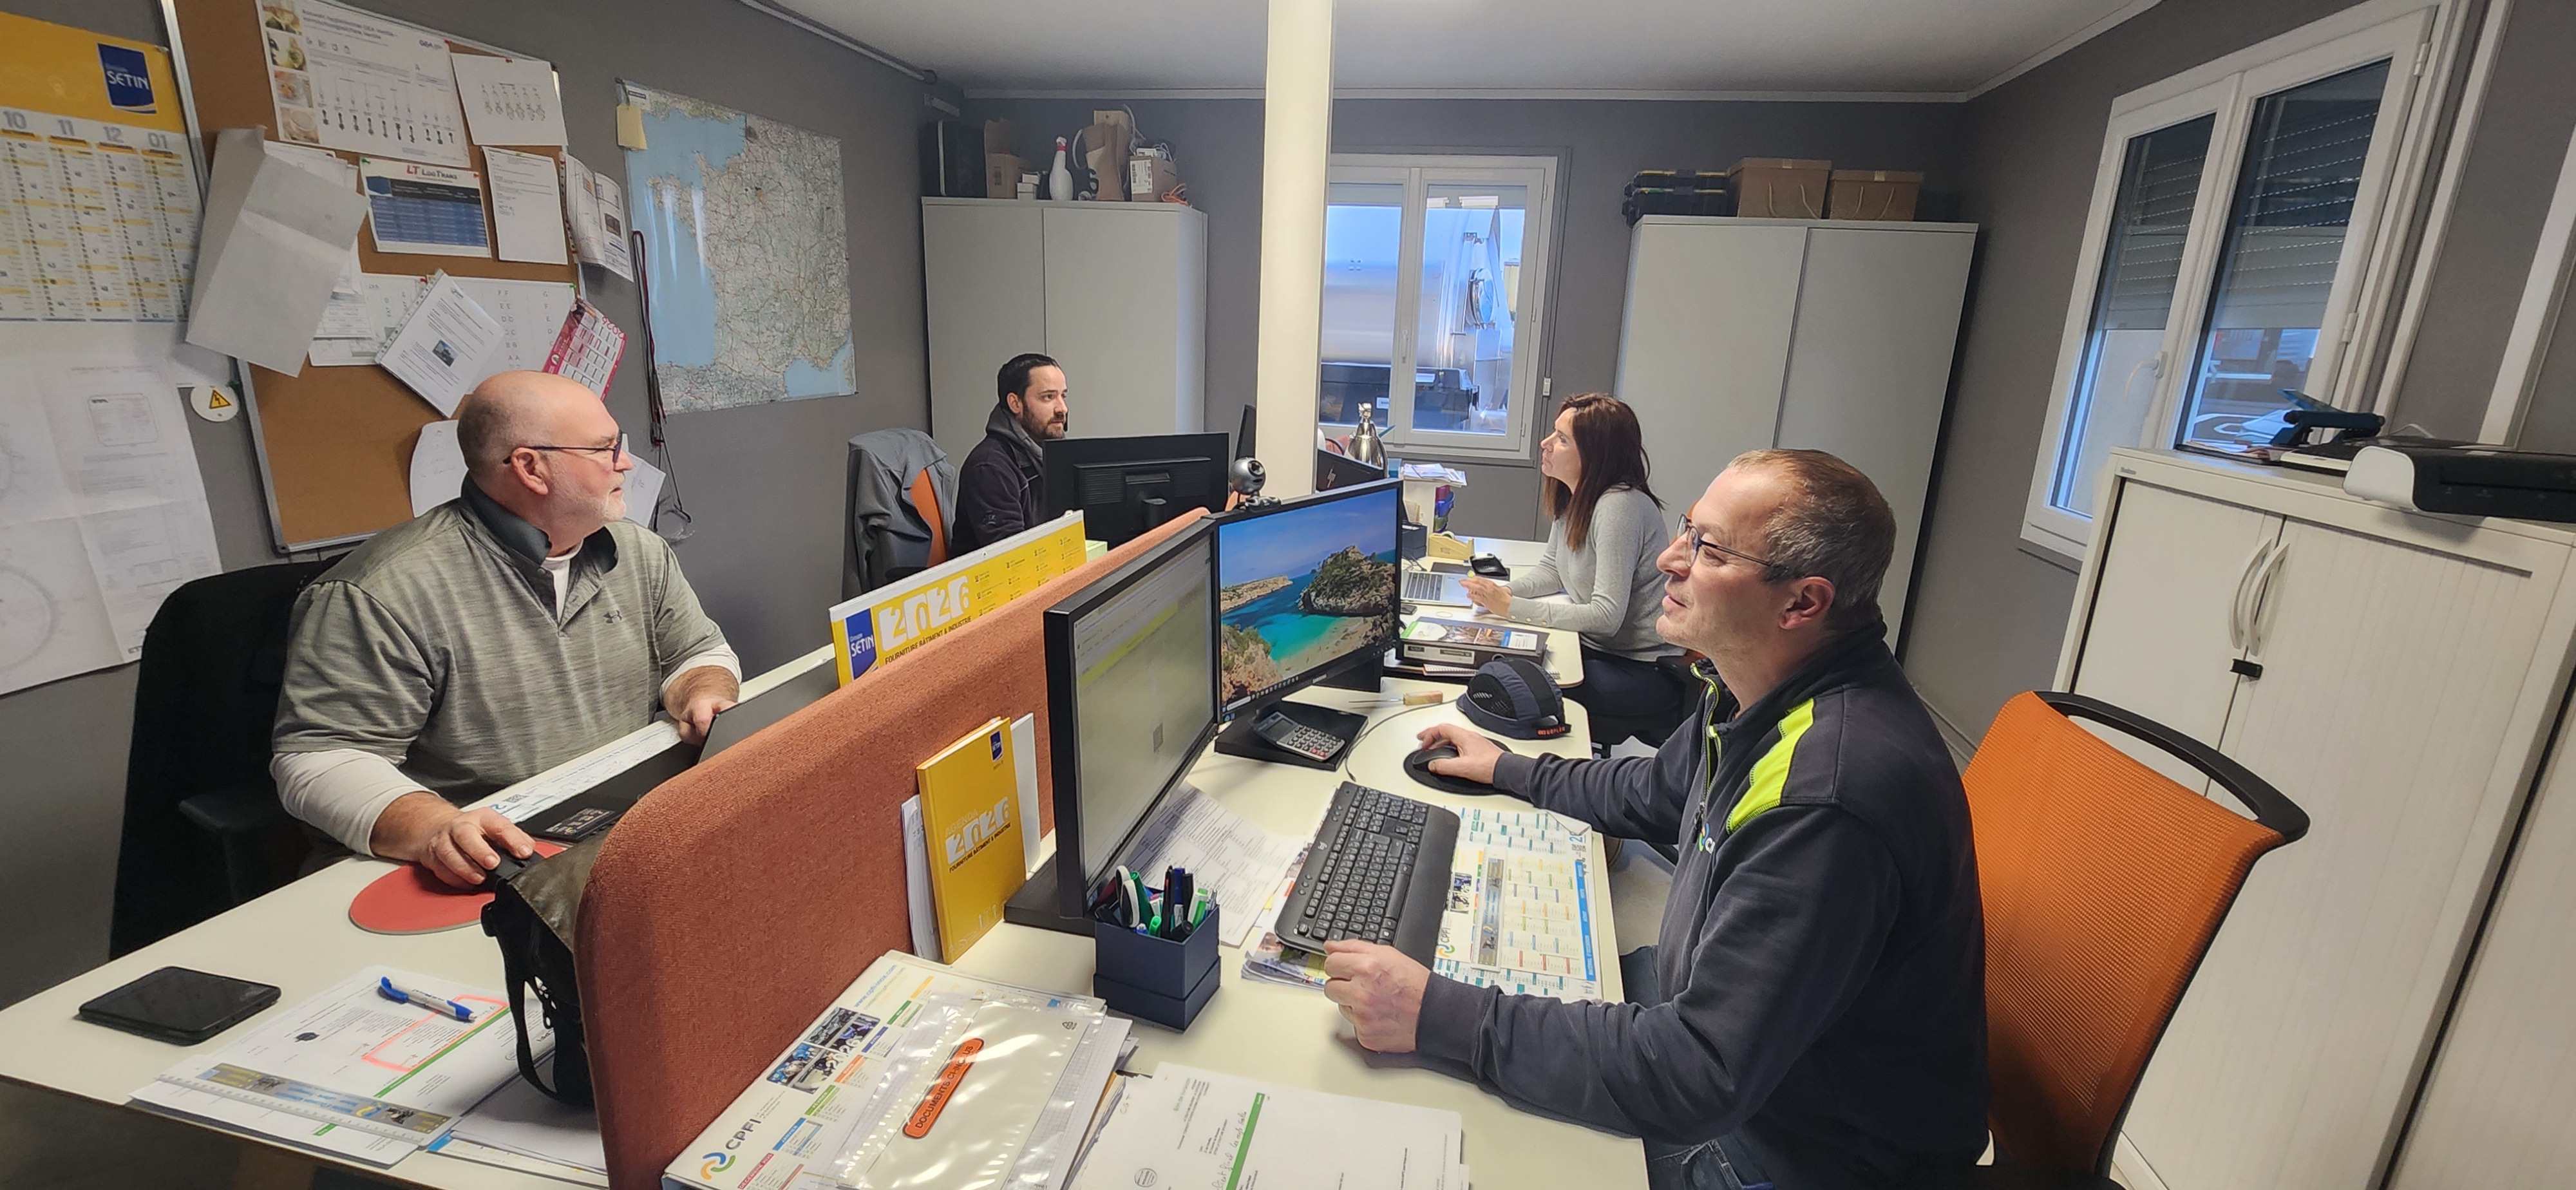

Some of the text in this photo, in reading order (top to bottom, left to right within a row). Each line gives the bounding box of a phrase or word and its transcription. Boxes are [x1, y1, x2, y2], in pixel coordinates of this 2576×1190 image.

[107, 70, 150, 90] SETIN
[3, 111, 168, 149] 10 11 12 01
[406, 165, 420, 175] LT
[602, 316, 626, 339] 2026
[878, 575, 970, 652] 2026
[851, 634, 875, 657] SETIN
[884, 641, 919, 666] FOURNITURE
[948, 616, 972, 633] INDUSTRIE
[945, 796, 1010, 865] 2026
[1440, 925, 1451, 943] CPFI
[915, 1046, 974, 1129] DOCUMENTS CI-INCUS
[724, 1118, 762, 1151] CPFI
[781, 1124, 799, 1144] JANVIER
